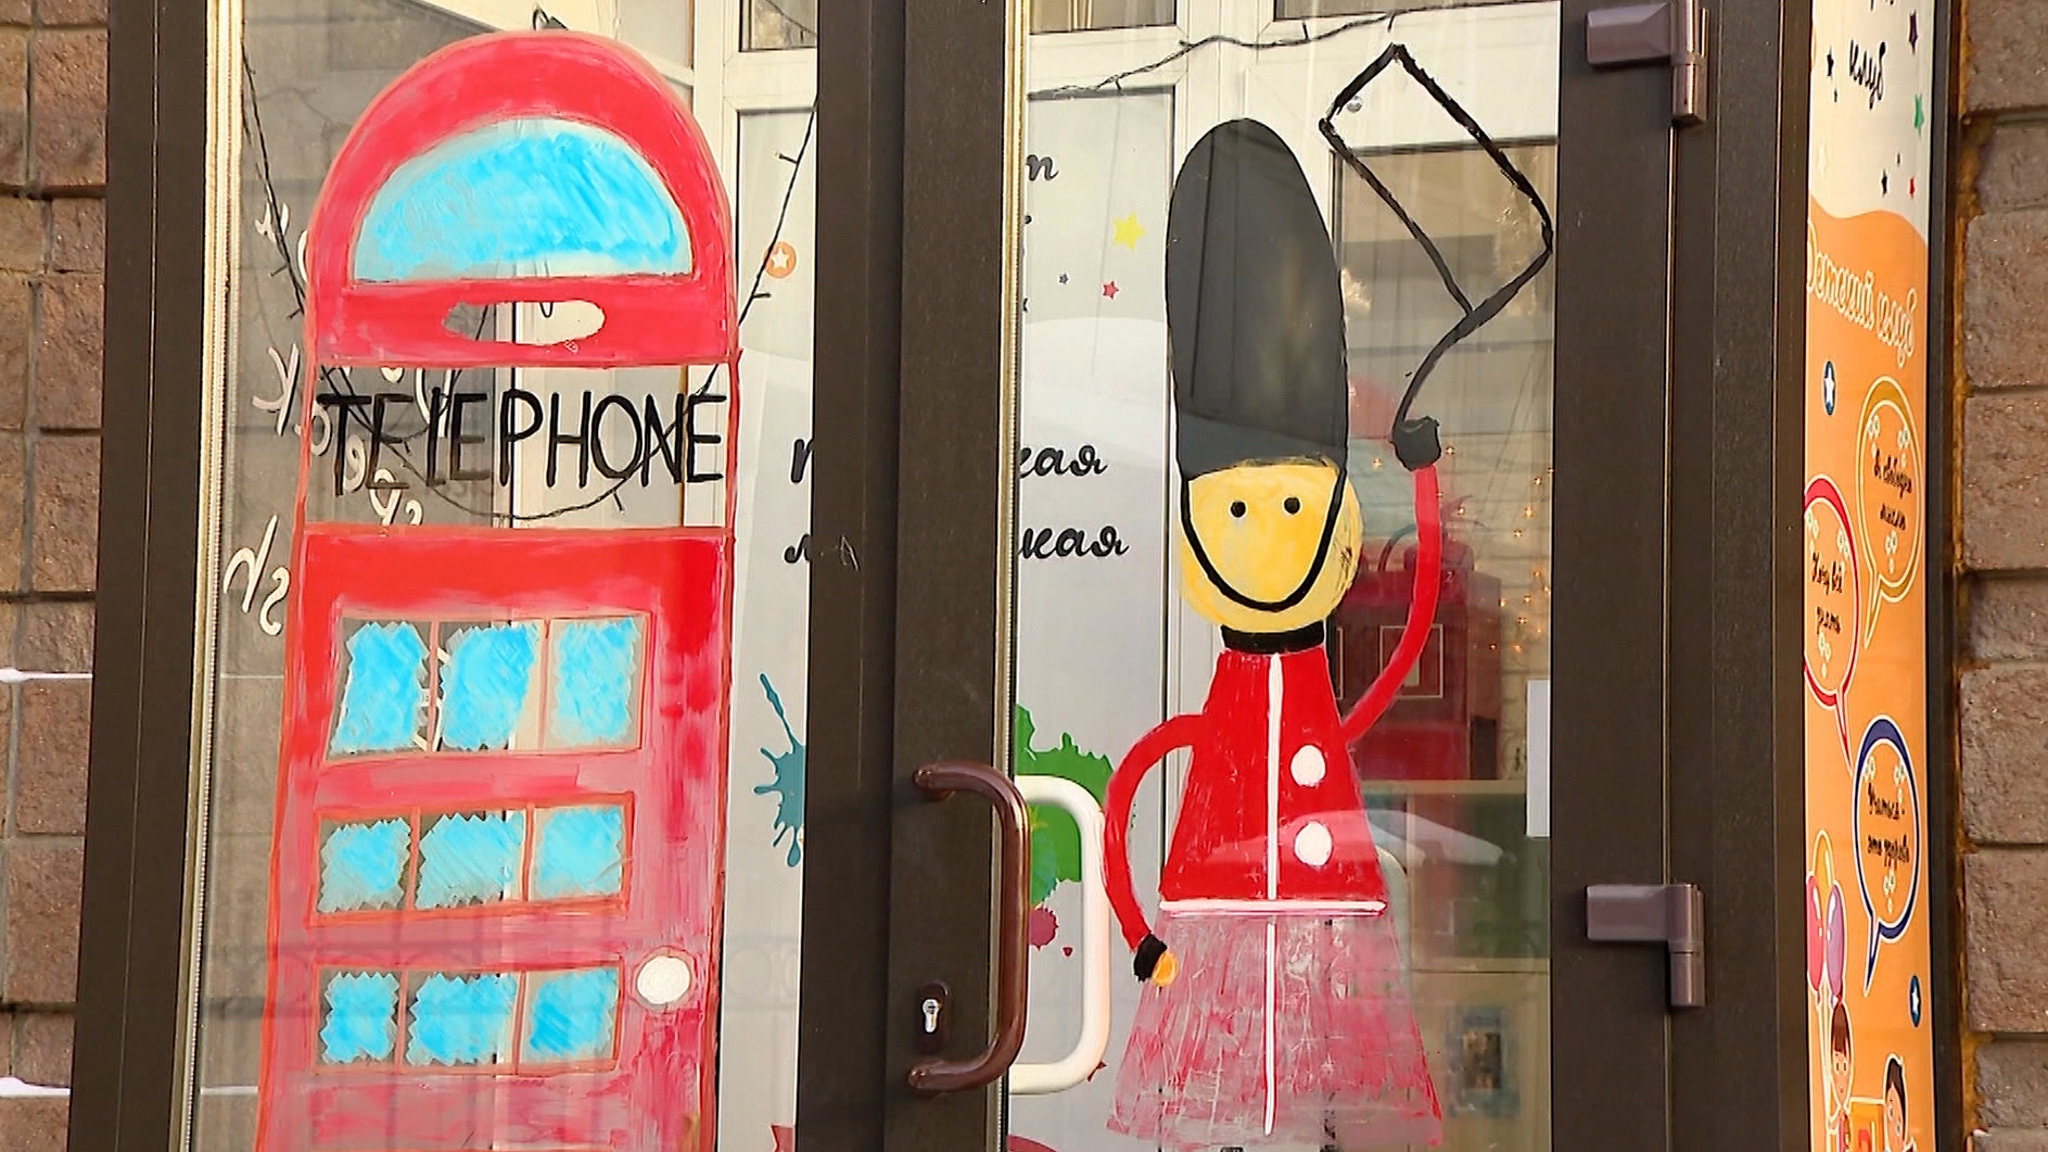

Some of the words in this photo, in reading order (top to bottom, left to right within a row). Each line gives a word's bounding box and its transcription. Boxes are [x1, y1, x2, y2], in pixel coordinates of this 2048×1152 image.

[1848, 39, 1887, 110] клуб
[1876, 287, 1918, 368] клуб
[316, 386, 728, 498] TELEPHONE
